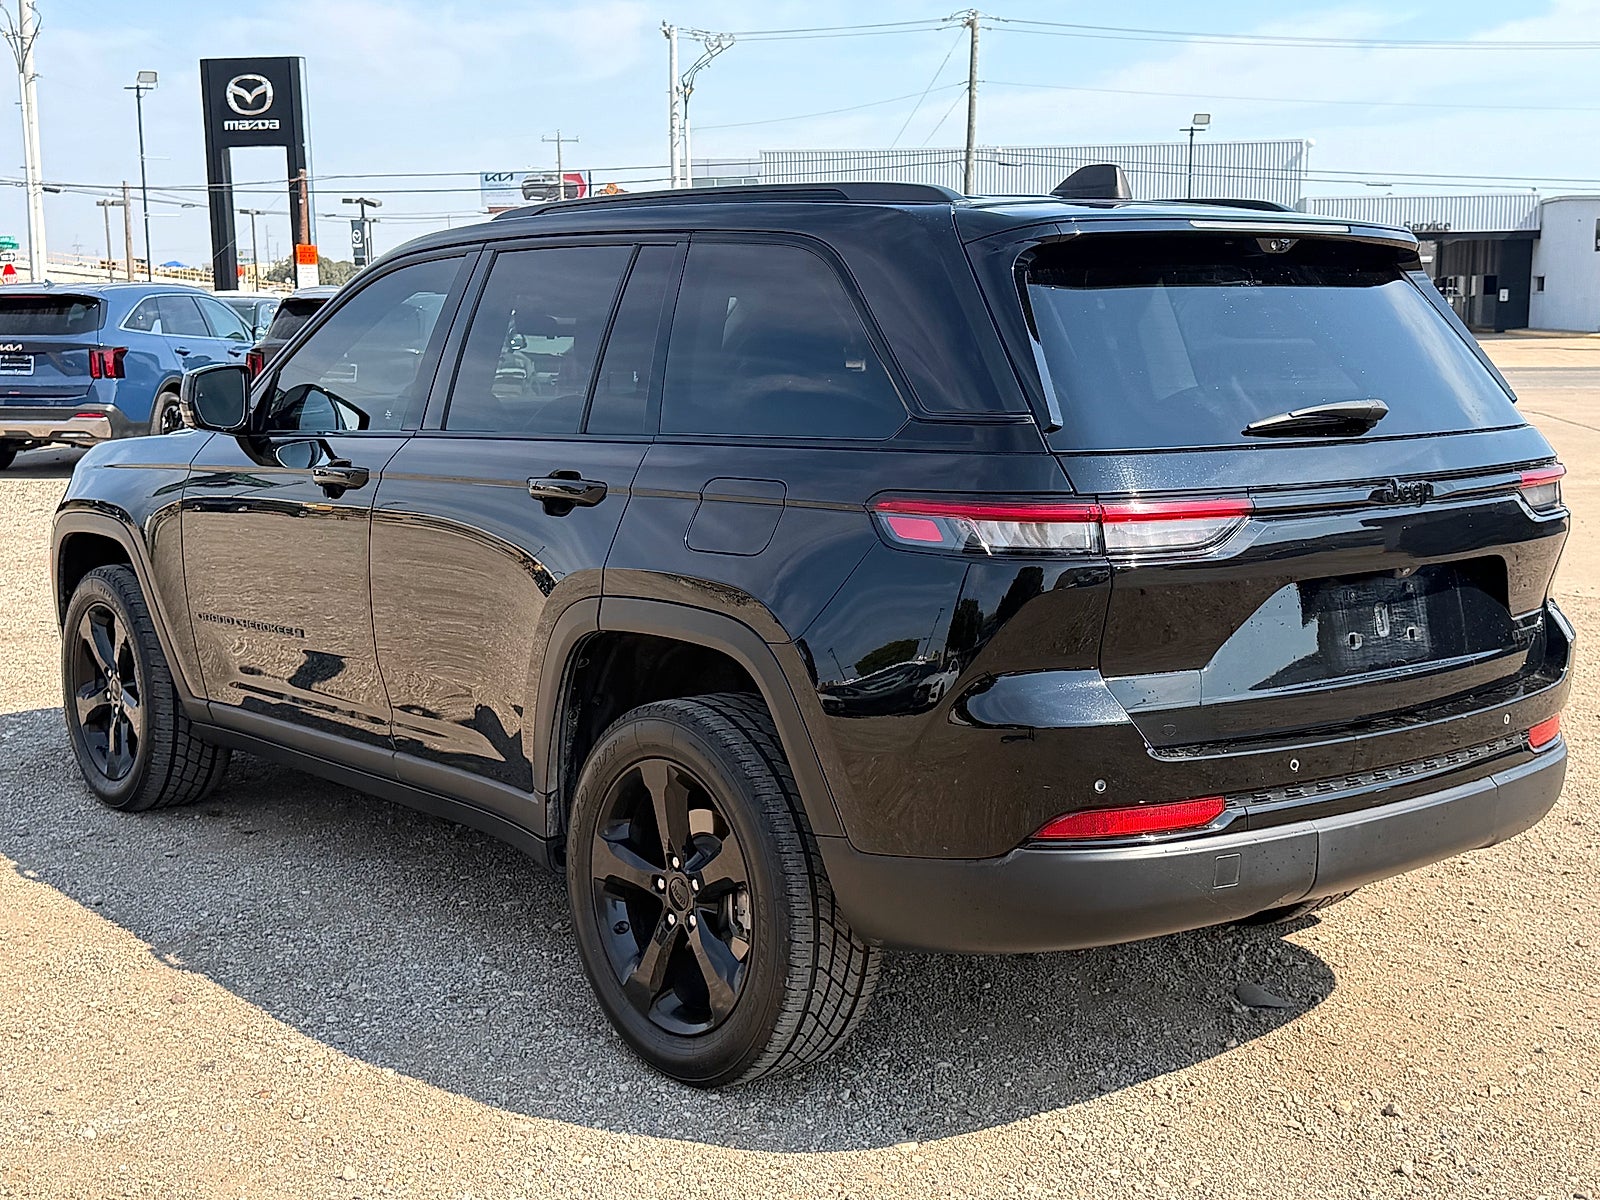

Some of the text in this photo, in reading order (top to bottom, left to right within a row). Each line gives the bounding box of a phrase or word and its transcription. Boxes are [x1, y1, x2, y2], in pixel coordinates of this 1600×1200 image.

[223, 119, 280, 131] mazda
[485, 172, 514, 182] KIA
[1403, 220, 1451, 231] Service
[1387, 477, 1434, 506] Jeep
